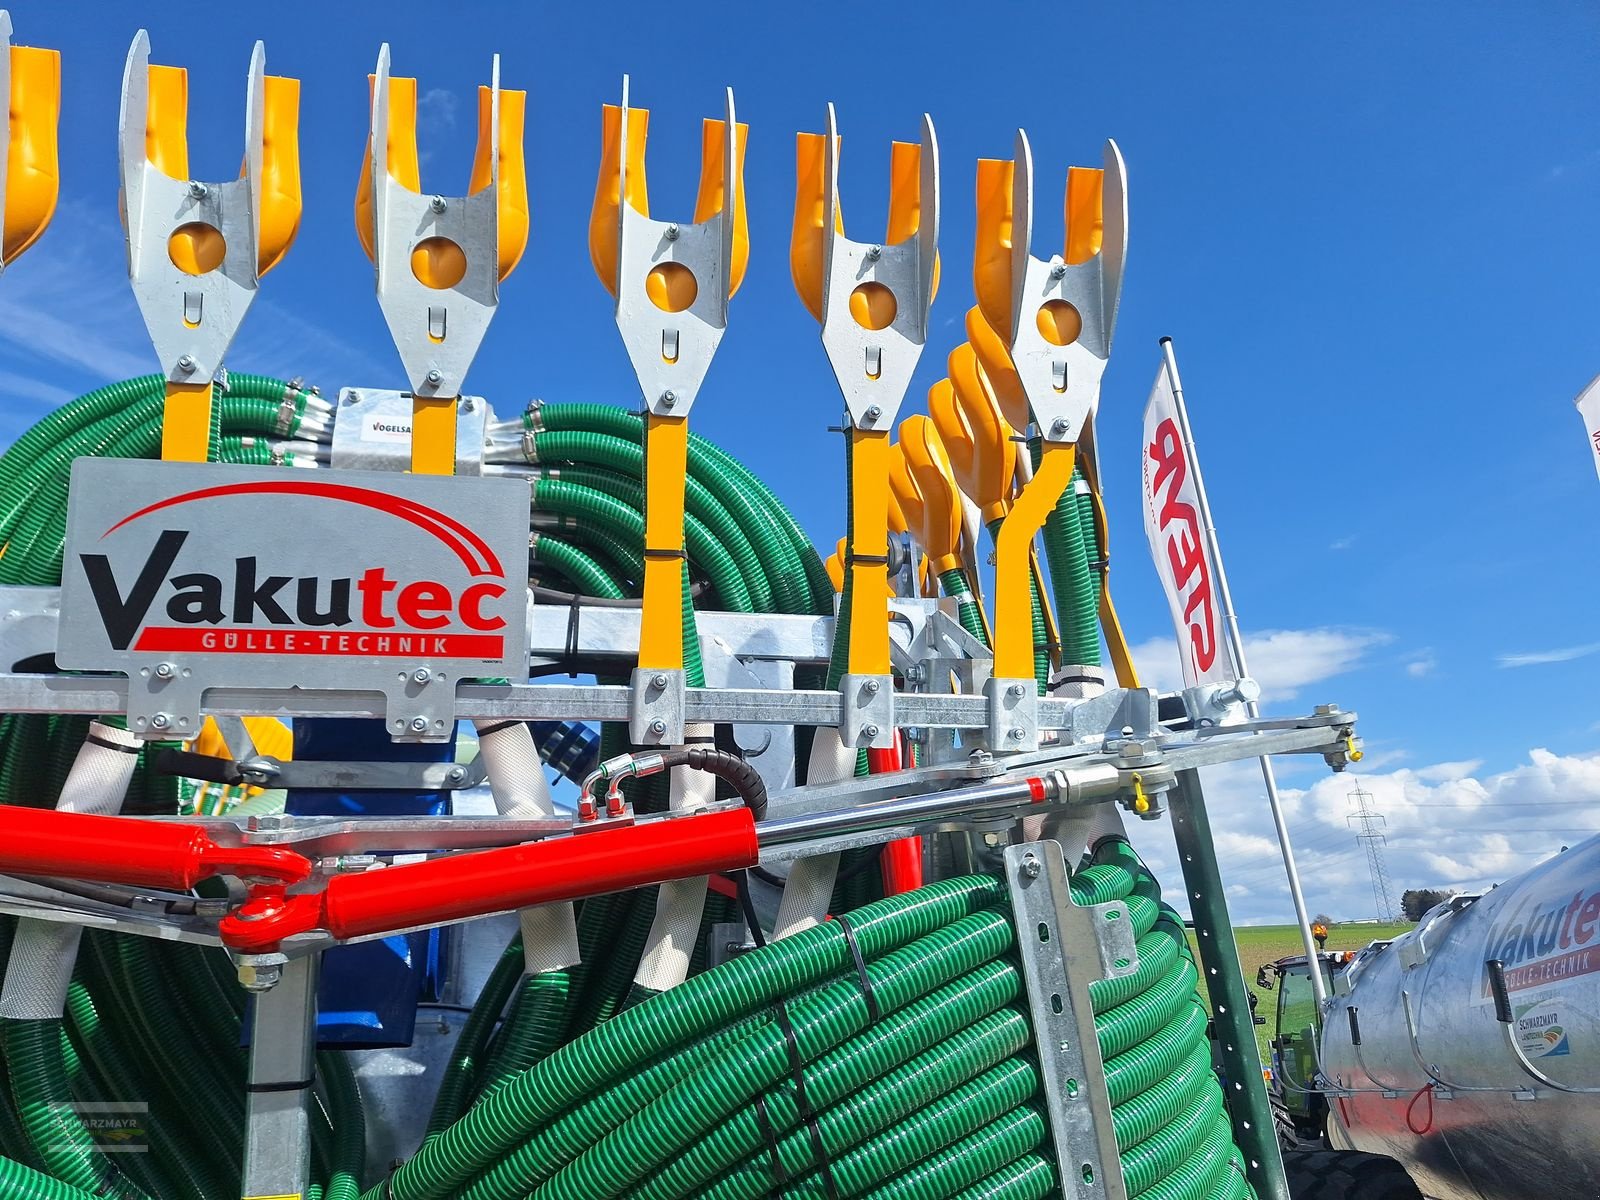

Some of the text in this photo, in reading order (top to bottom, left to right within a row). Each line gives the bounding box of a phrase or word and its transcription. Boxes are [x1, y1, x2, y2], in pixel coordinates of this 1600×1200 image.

[372, 422, 411, 433] VOGELSA
[79, 530, 506, 650] Vakutec
[201, 631, 448, 654] GÜLLE-TECHNIK
[1481, 889, 1600, 998] Vakute
